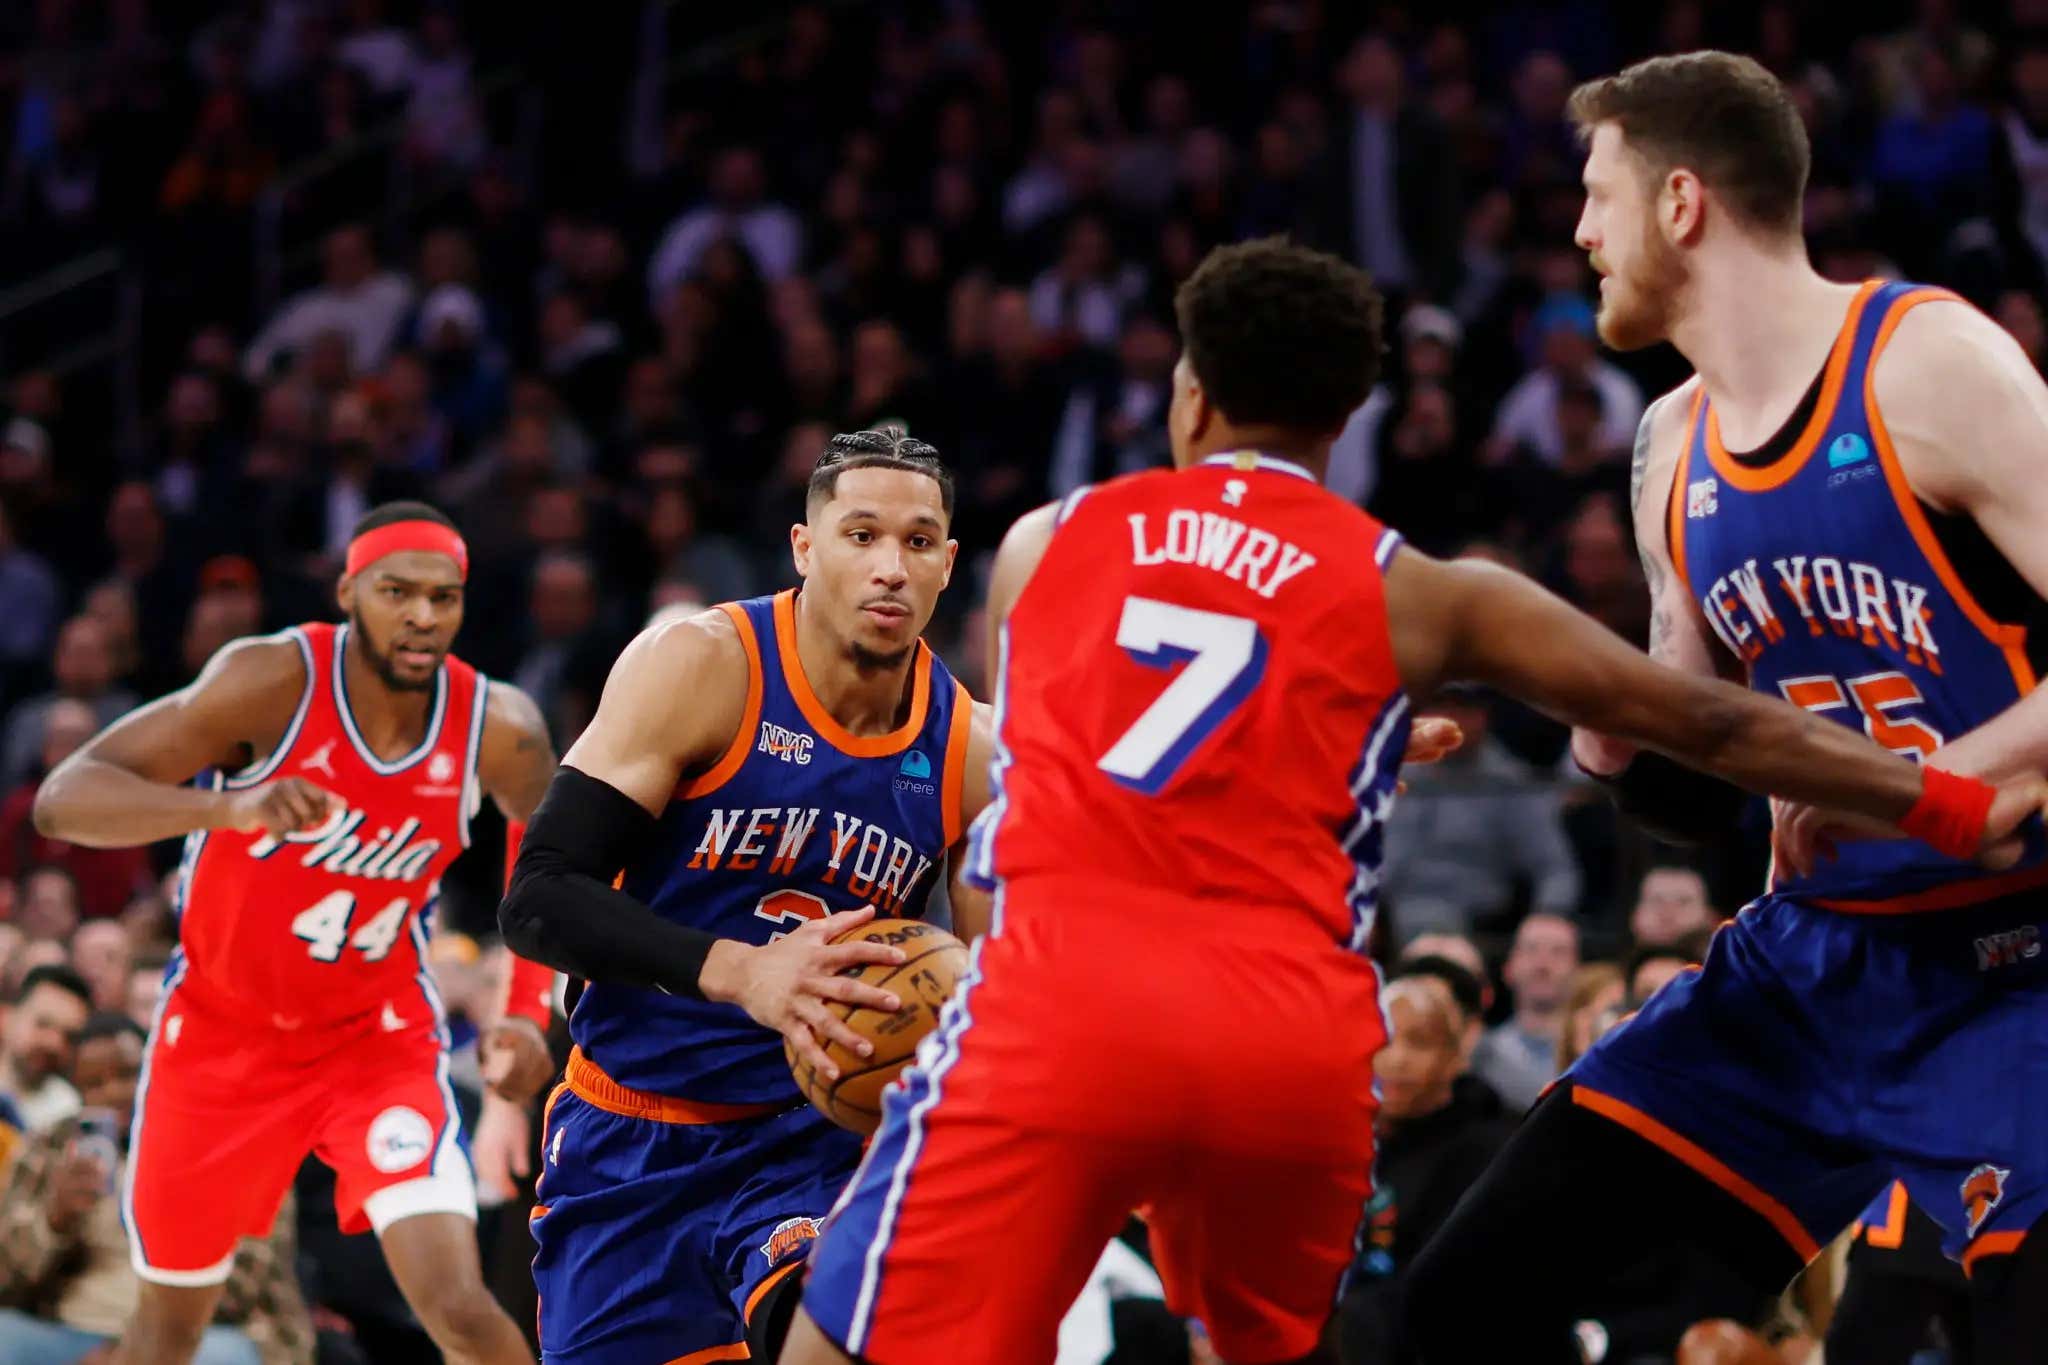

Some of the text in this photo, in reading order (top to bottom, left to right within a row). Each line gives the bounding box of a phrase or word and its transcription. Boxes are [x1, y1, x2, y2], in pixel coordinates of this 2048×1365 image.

[1127, 508, 1317, 598] LOWRY
[1772, 556, 1940, 655] YORK
[1097, 595, 1272, 796] 7
[757, 721, 814, 765] NYC
[894, 777, 935, 796] sphere
[693, 807, 932, 903] NEW YORK
[291, 889, 410, 963] 44
